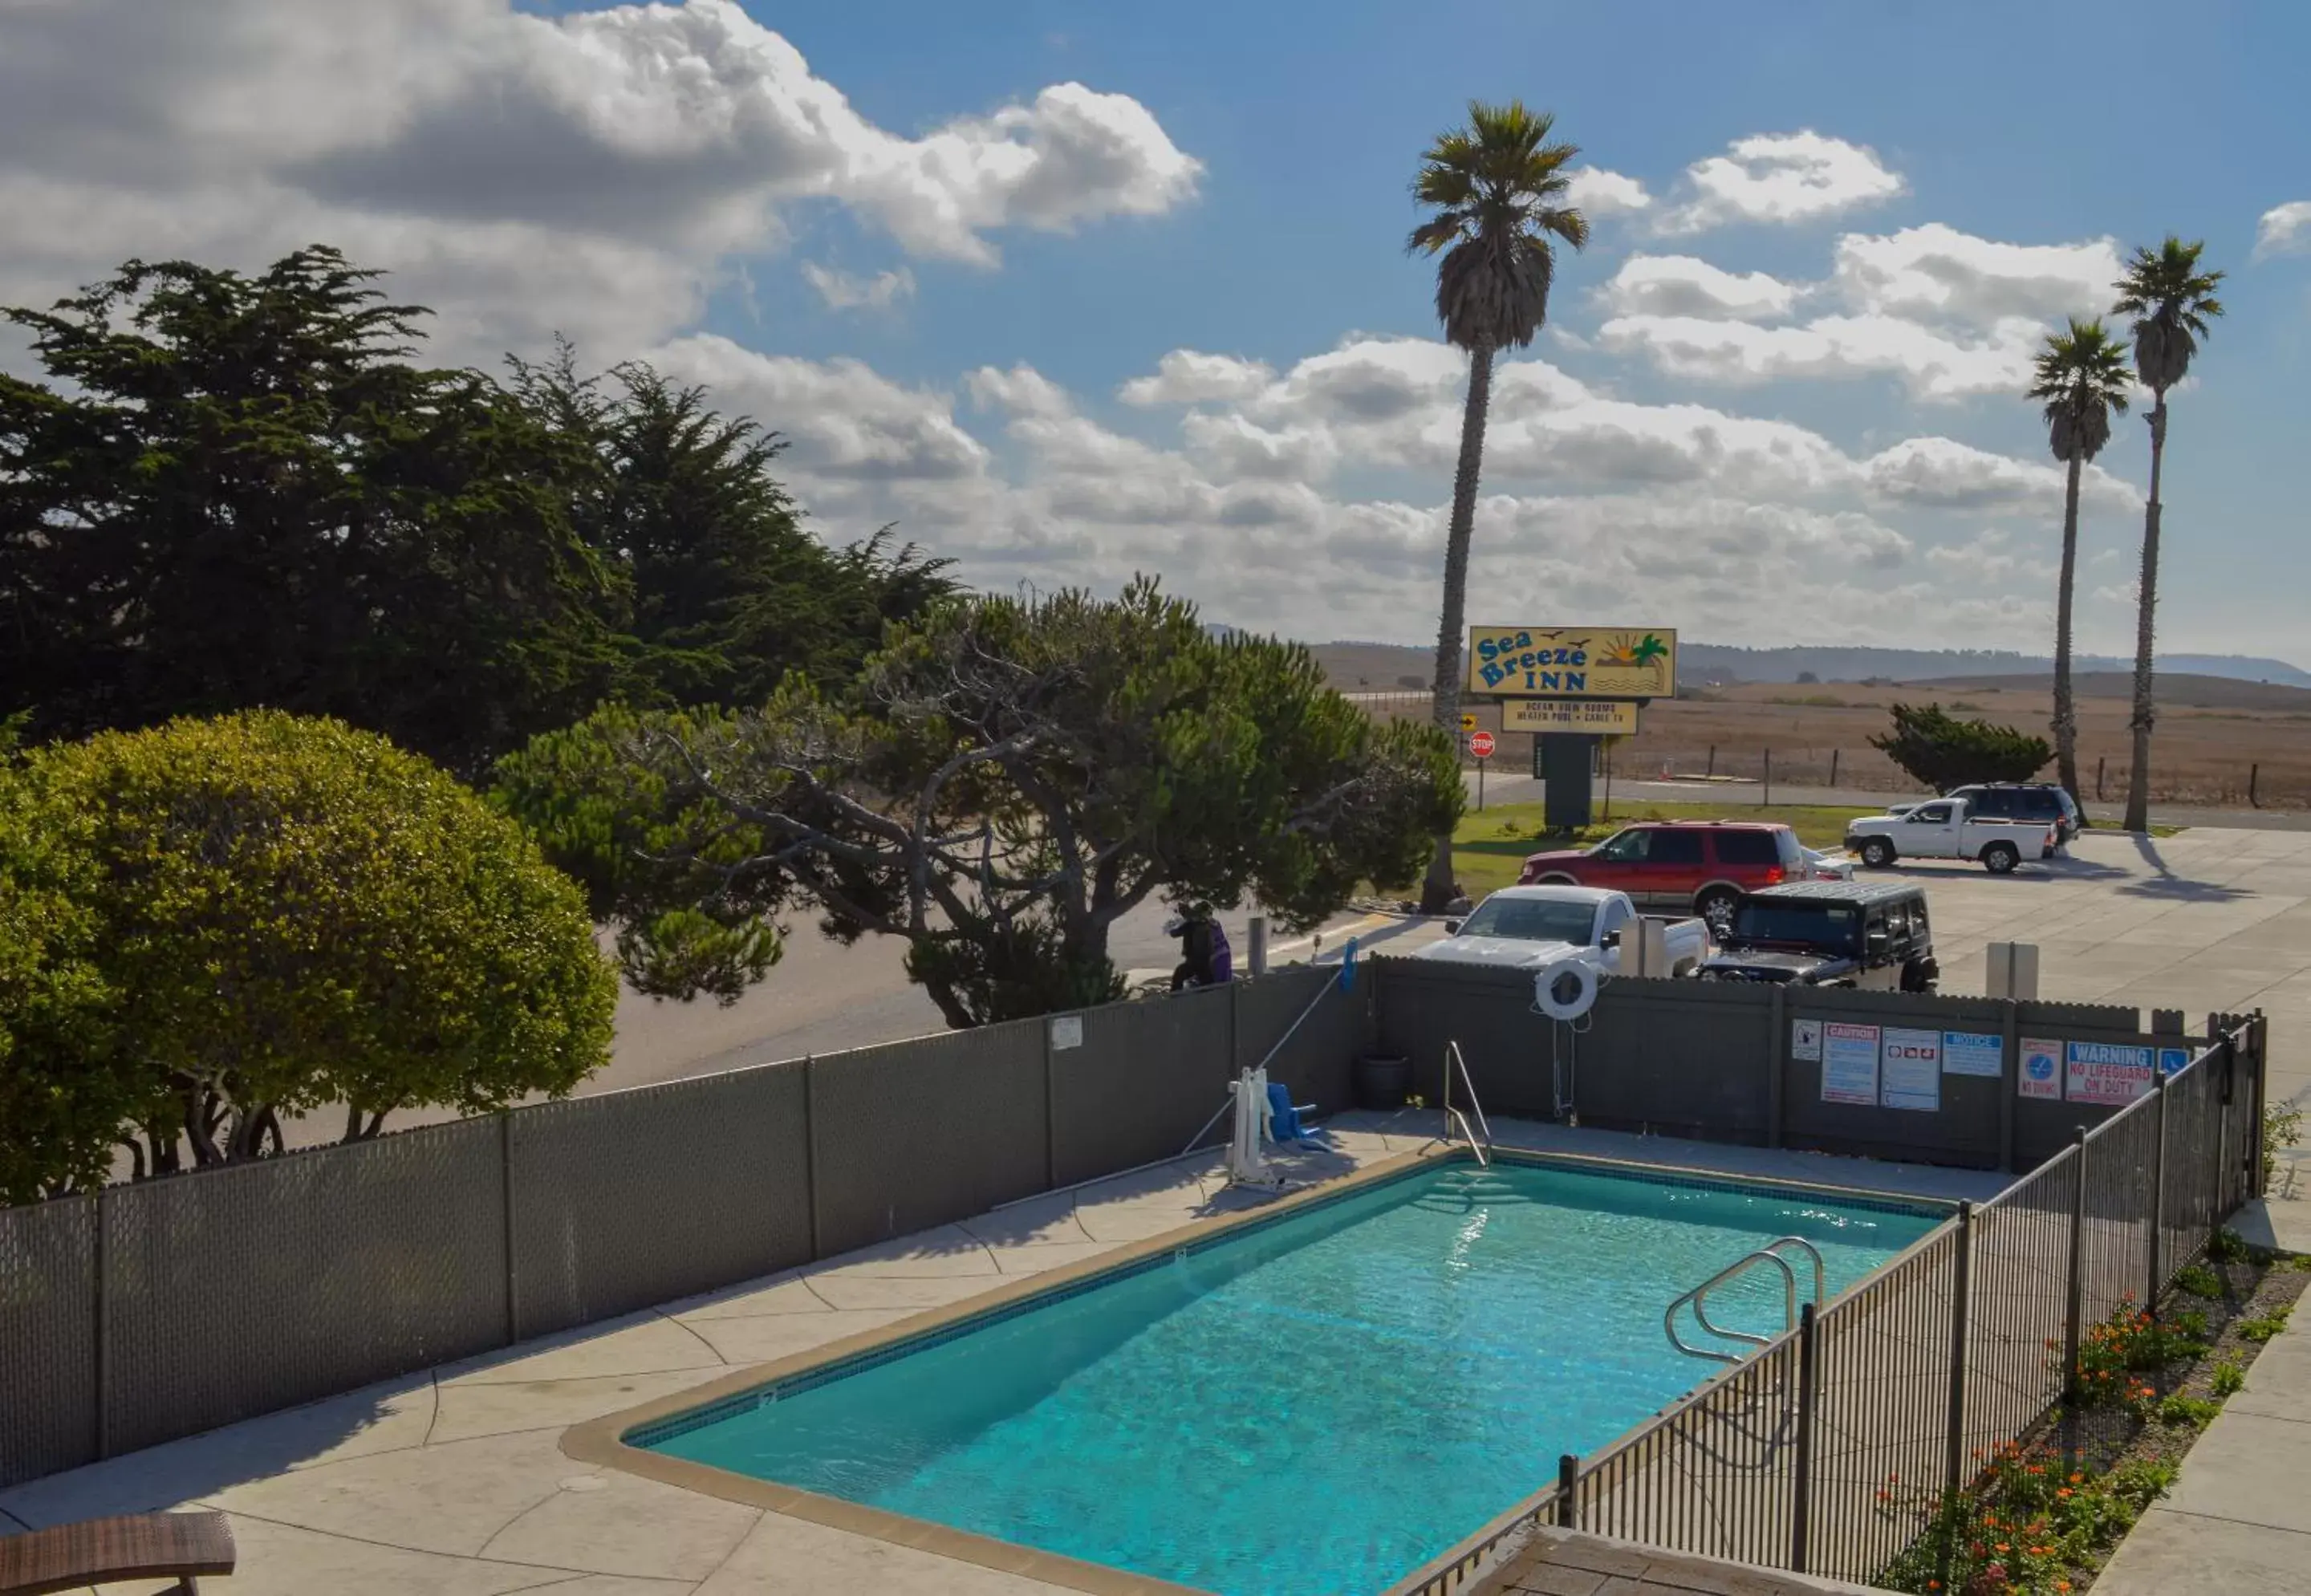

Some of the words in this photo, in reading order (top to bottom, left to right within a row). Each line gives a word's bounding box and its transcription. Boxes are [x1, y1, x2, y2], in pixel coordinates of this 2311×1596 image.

[1477, 631, 1532, 662] Sea
[1479, 648, 1587, 688] Breeze
[1525, 672, 1587, 691] INN
[1472, 739, 1493, 749] STOP
[1830, 1028, 1875, 1040] CAUTION
[1953, 1034, 1993, 1046] NOTICE
[2076, 1043, 2147, 1066] WARNING
[2070, 1062, 2085, 1075] NO
[2090, 1065, 2151, 1081] LIFEGUARD
[2085, 1078, 2099, 1091] ON
[2105, 1080, 2134, 1094] DUTY
